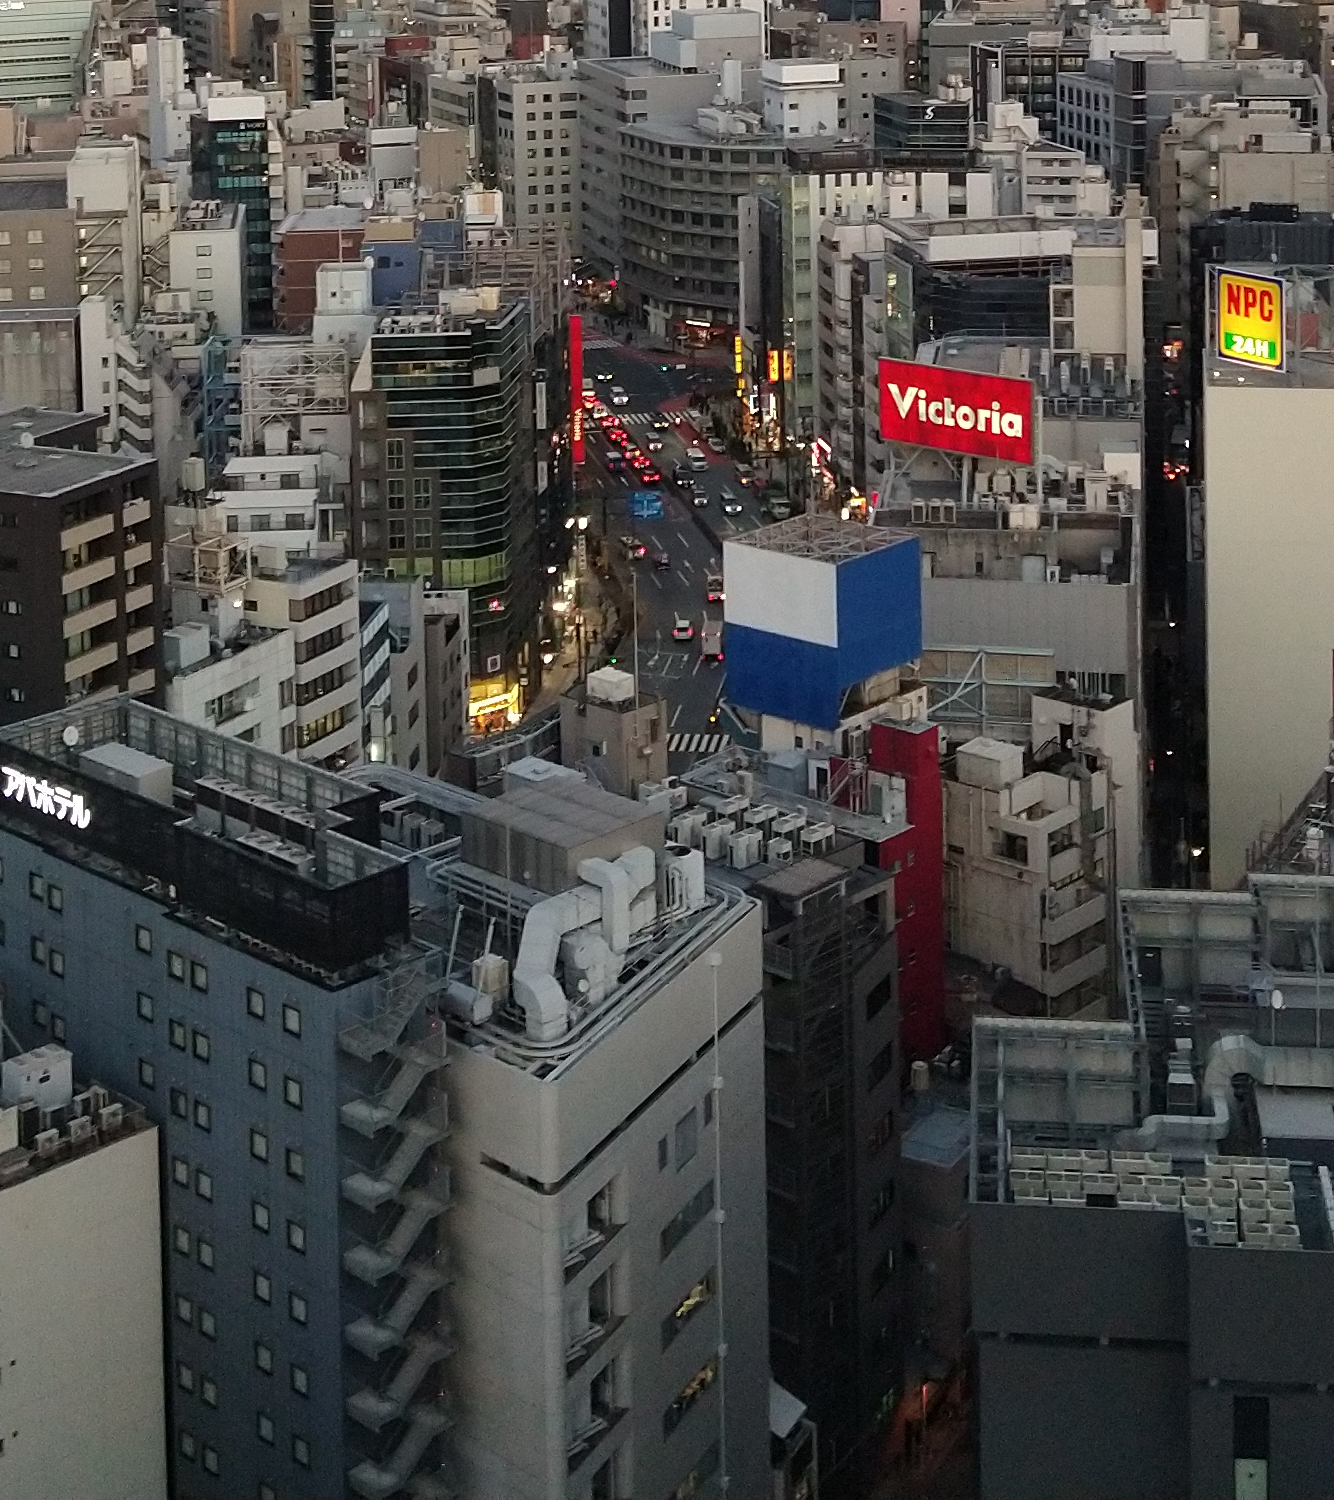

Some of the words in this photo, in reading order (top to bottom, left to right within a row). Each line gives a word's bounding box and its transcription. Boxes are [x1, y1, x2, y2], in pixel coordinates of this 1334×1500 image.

[1227, 283, 1273, 323] NPC
[1231, 335, 1269, 359] 24H
[887, 383, 1023, 439] Victoria
[1, 766, 91, 829] アパホテル
